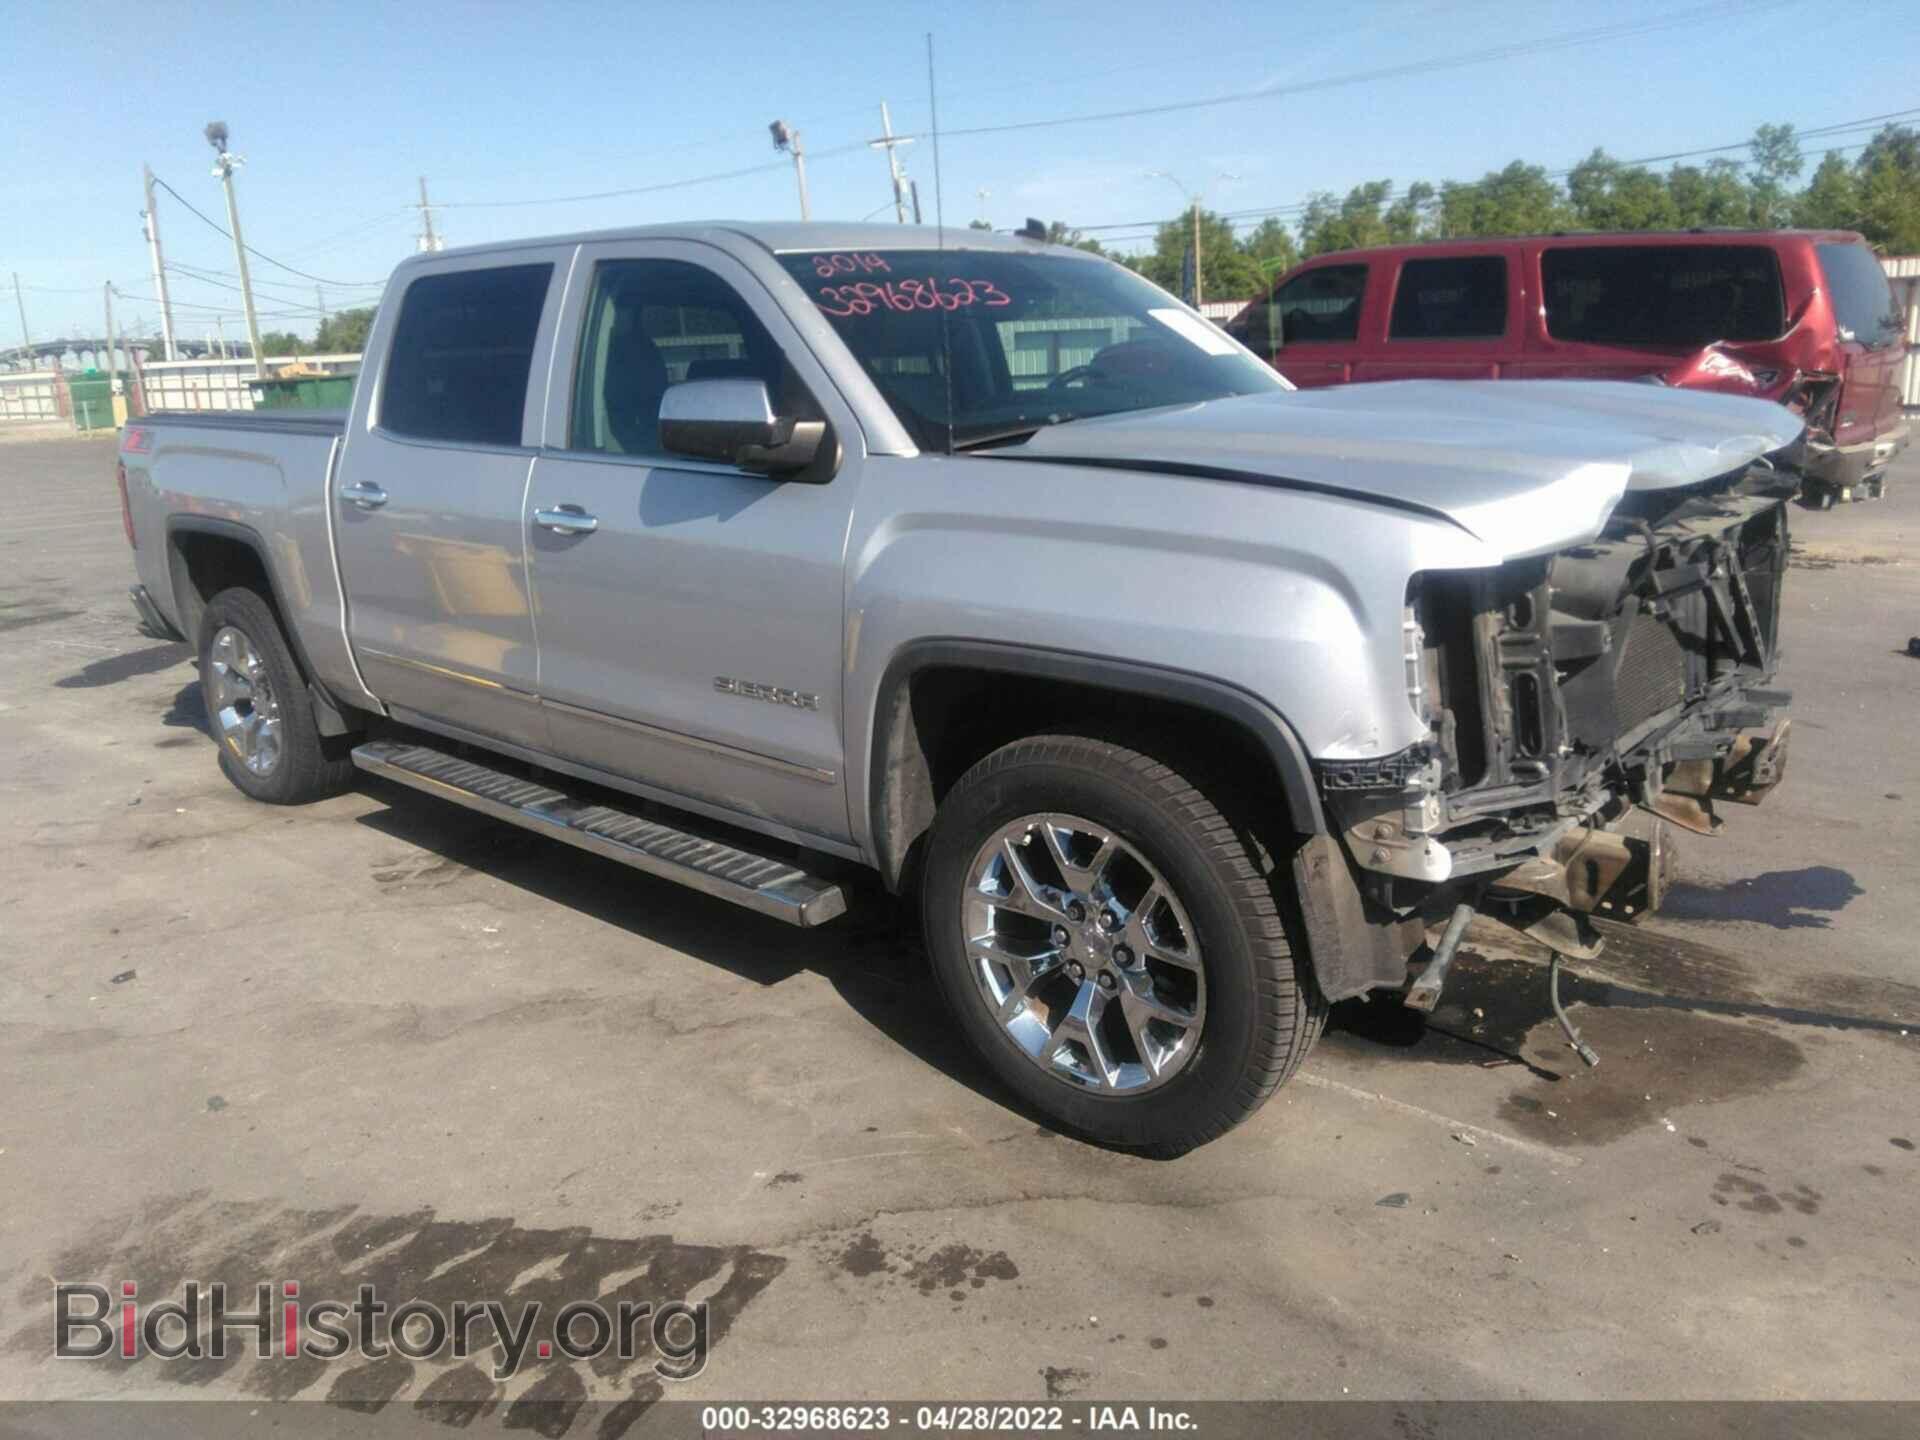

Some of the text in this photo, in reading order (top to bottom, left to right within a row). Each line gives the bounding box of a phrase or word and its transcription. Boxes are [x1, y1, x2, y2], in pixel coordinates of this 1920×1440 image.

[812, 252, 891, 278] 2014
[816, 276, 1011, 317] 32968623
[713, 675, 820, 712] SIERRA
